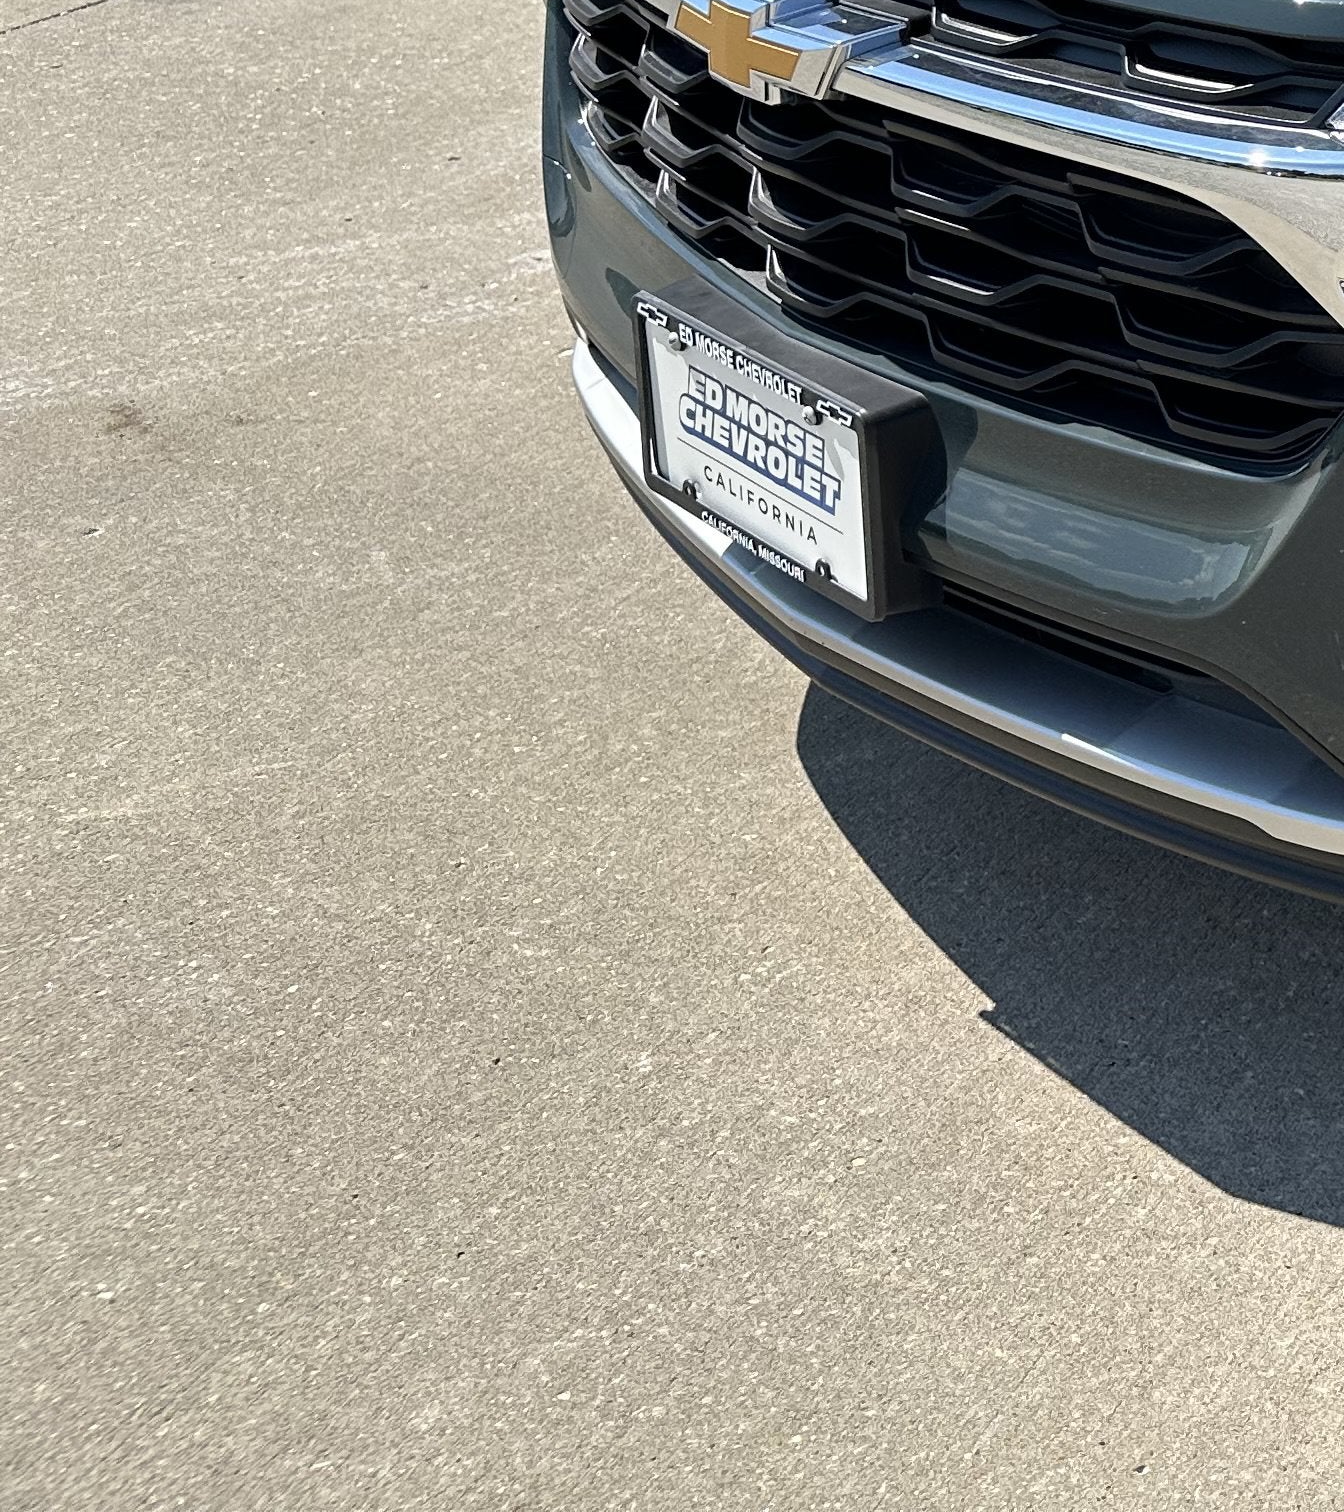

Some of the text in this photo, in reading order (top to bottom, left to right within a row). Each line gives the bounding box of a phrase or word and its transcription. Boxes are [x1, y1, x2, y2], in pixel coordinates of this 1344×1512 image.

[679, 322, 803, 405] ED MORSE CHEVROLET
[679, 392, 842, 516] CHEVROLET
[688, 364, 825, 473] ED MORSE
[701, 510, 805, 583] CALIFORNIA, MISSOURI
[704, 465, 818, 546] CALIFORNIA
